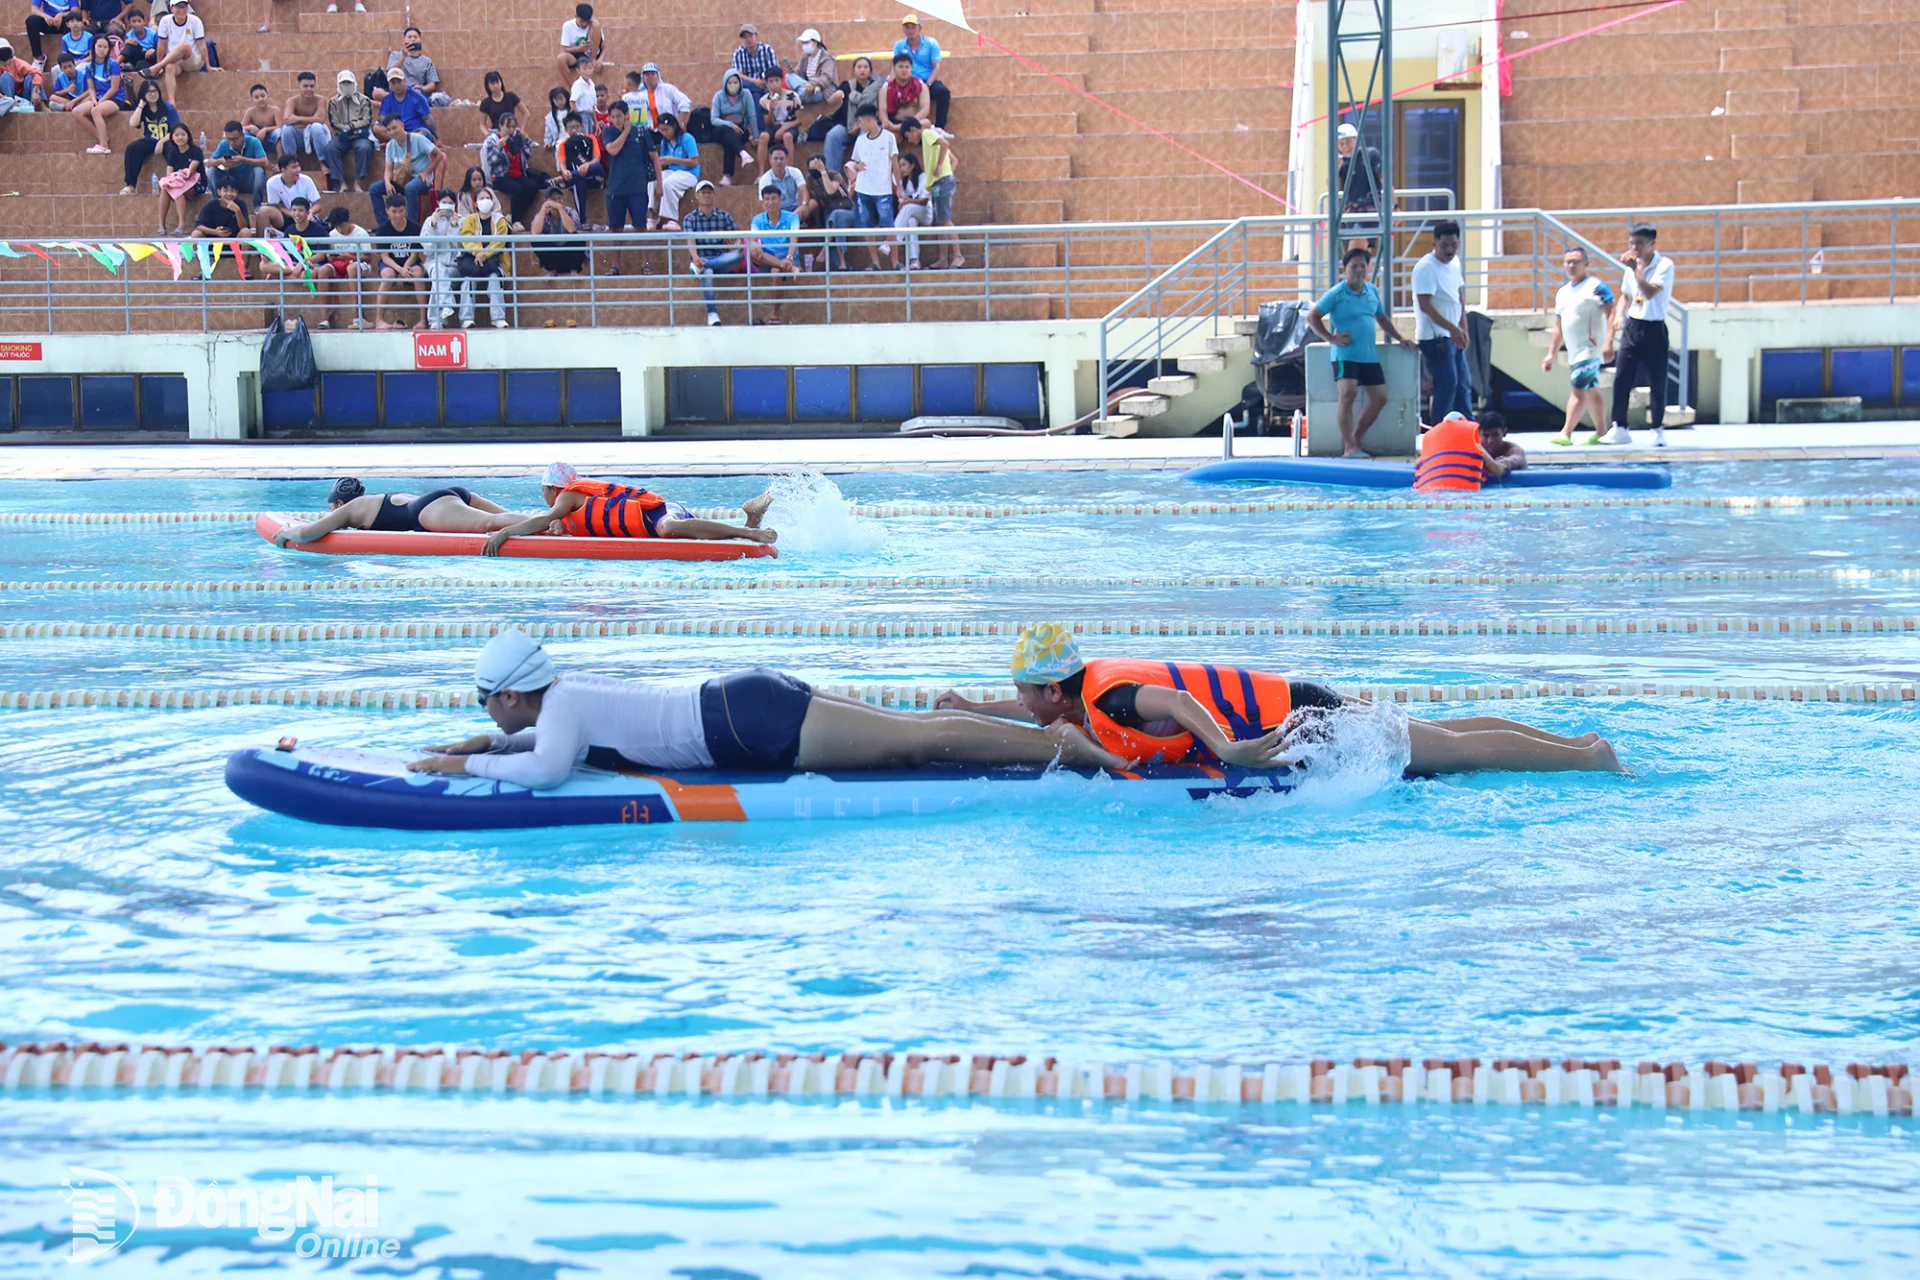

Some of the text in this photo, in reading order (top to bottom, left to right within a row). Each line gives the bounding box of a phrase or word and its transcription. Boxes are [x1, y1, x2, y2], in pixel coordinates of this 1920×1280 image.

[633, 107, 642, 123] 7
[0, 344, 33, 352] SMOKING
[418, 344, 447, 357] NAM
